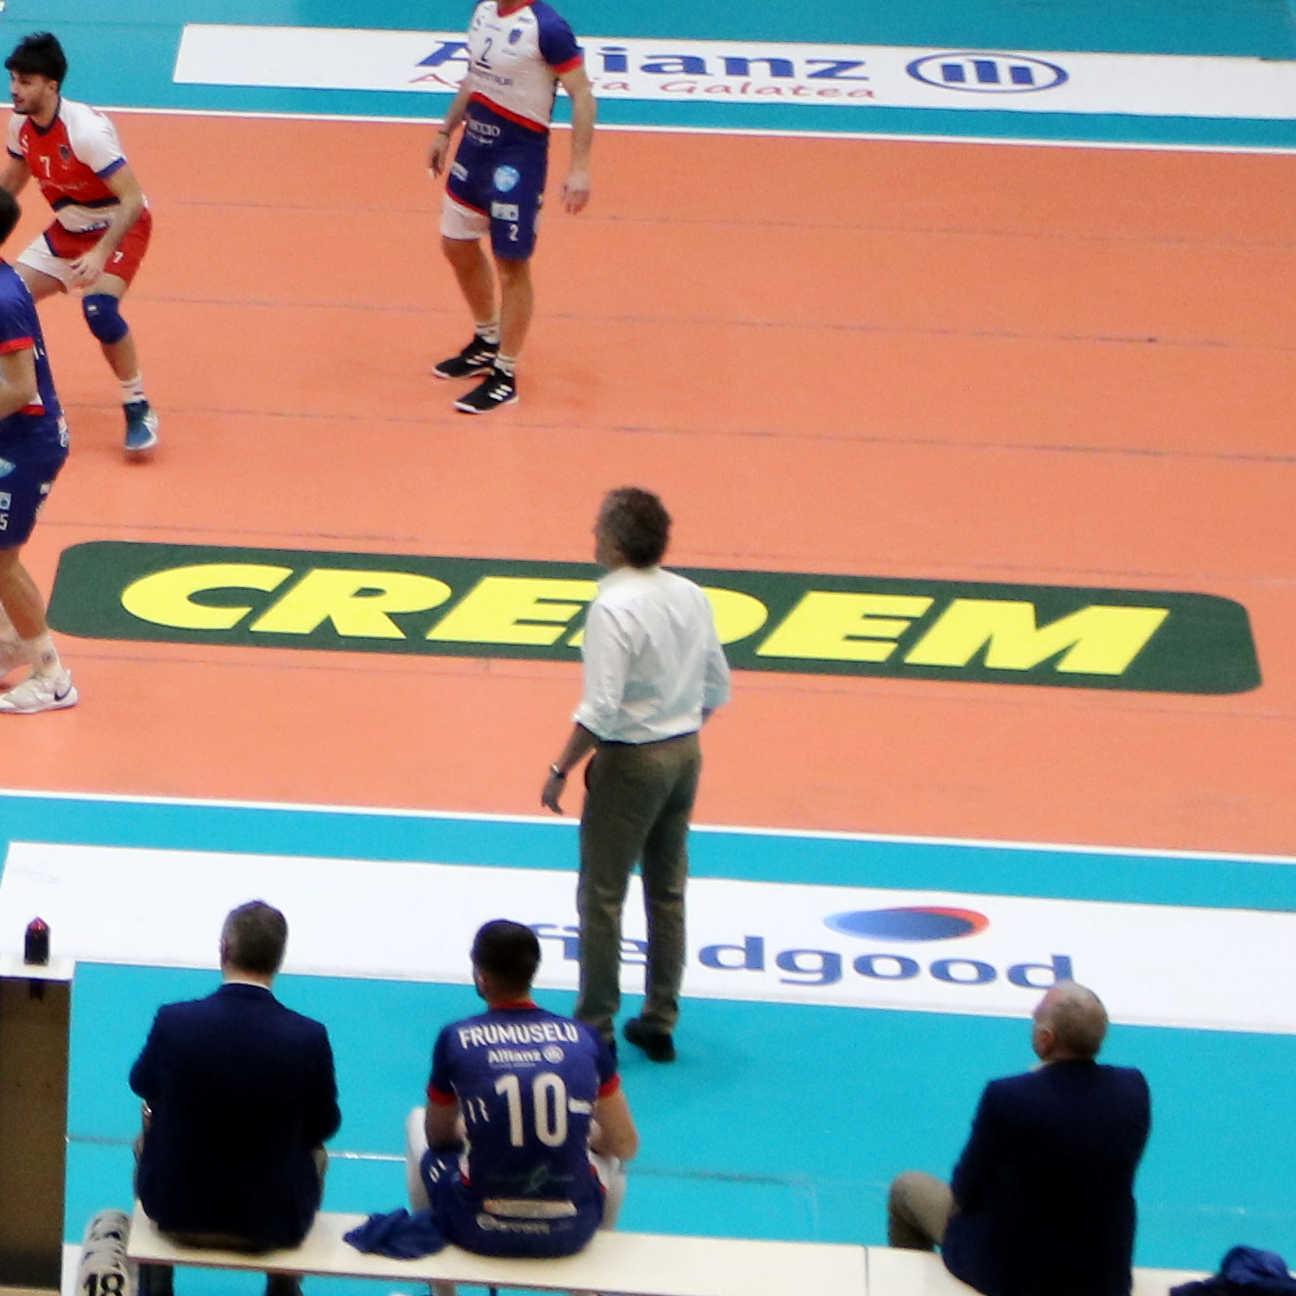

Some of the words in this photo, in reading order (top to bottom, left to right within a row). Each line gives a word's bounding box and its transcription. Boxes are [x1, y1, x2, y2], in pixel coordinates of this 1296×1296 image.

[416, 38, 870, 82] Aianz
[481, 37, 493, 63] 2
[659, 80, 876, 100] Galatea
[39, 156, 51, 179] 7
[509, 223, 519, 242] 2
[113, 251, 125, 264] 7
[459, 1021, 580, 1049] FRUMUSELU
[487, 1048, 542, 1065] Allianz
[494, 1071, 568, 1148] 10
